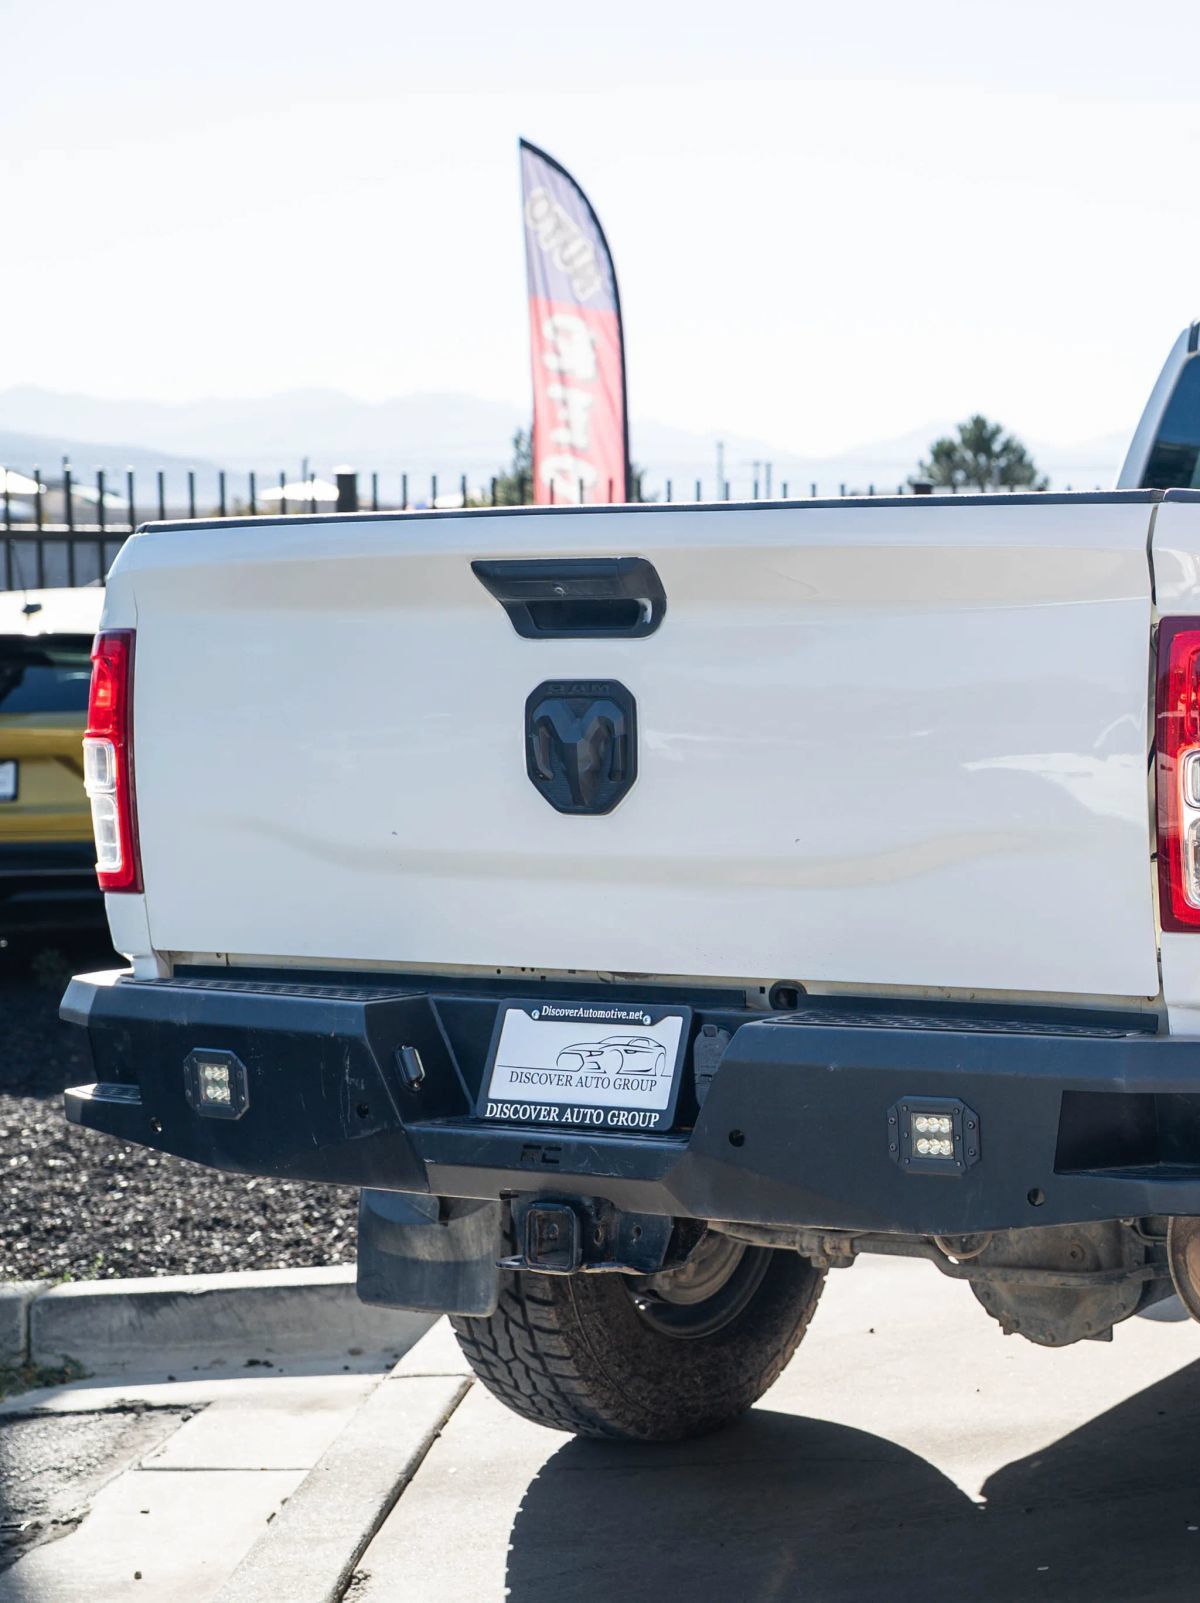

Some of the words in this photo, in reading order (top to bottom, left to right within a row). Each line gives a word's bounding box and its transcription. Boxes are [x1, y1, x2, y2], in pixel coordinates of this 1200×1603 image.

[541, 1005, 643, 1020] DiscoverAutomotive.net
[509, 1070, 573, 1087] DISCOVER
[575, 1075, 611, 1089] AUTO
[613, 1077, 657, 1092] GROUP
[485, 1102, 560, 1122] DISCOVER
[562, 1108, 604, 1125] AUTO
[607, 1111, 660, 1128] GROUP
